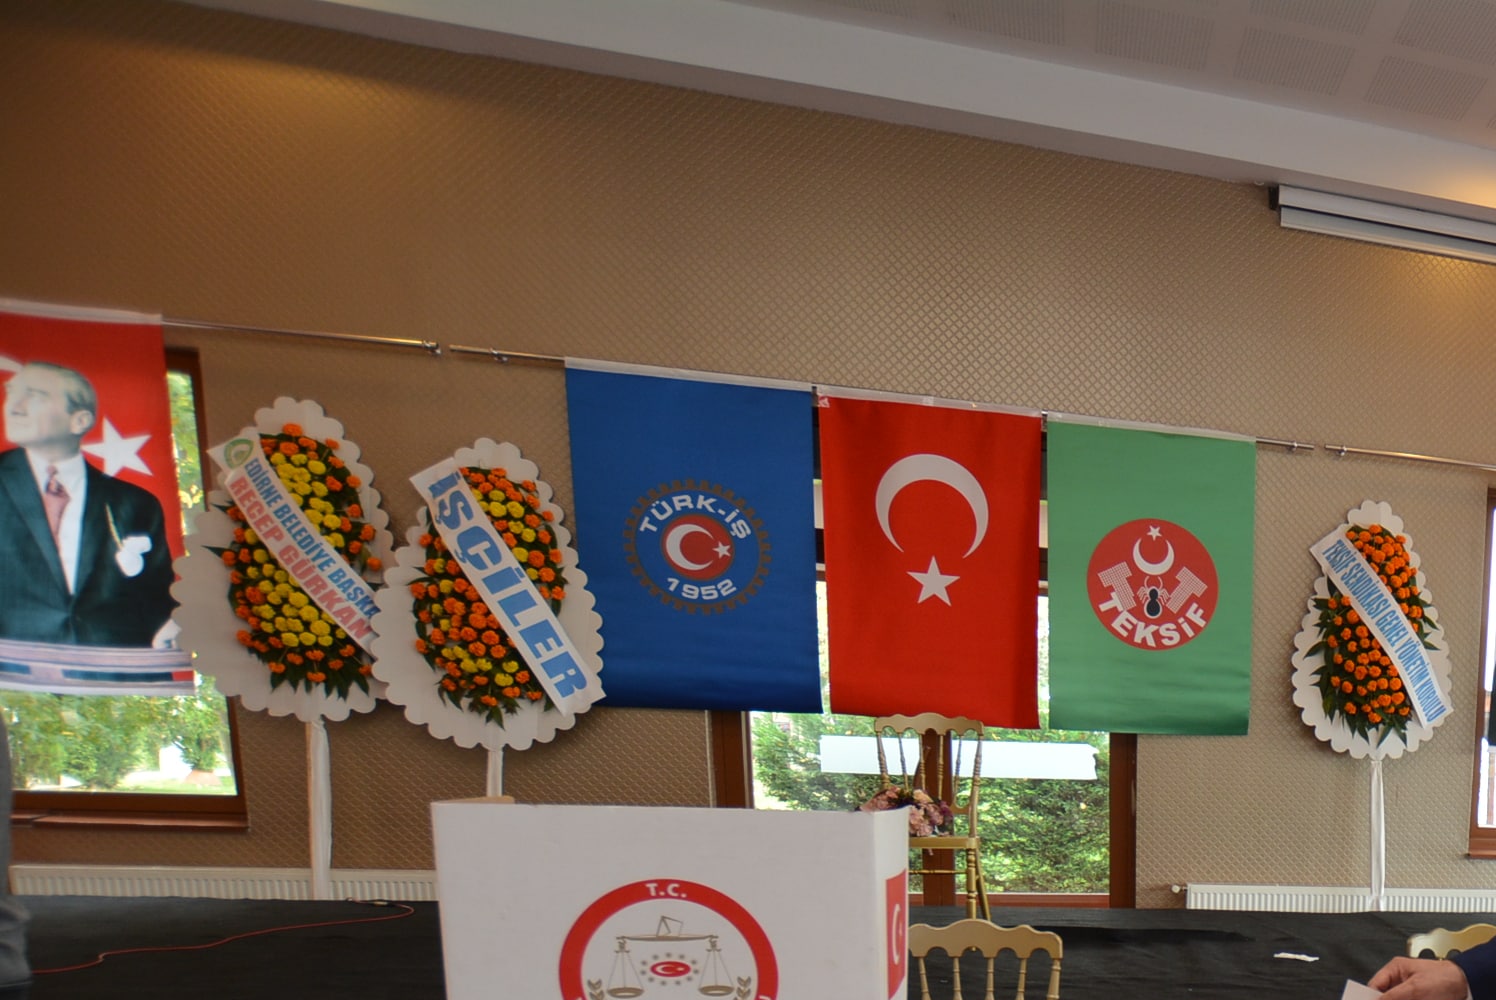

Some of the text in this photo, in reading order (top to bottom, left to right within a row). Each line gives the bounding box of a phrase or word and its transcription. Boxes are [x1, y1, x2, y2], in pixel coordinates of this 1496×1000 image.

[230, 475, 373, 640] RECEP GÜRKAN
[244, 457, 382, 619] EDİRNE BELEDİYE BAŞKA
[428, 469, 588, 699] İŞÇİLER
[639, 494, 752, 539] TÜRK-İŞ
[667, 577, 737, 600] 1952
[1321, 538, 1447, 723] TEKSİF SENDİKASI GENEL YÖNETİM KURULU
[645, 882, 688, 899] T.C.
